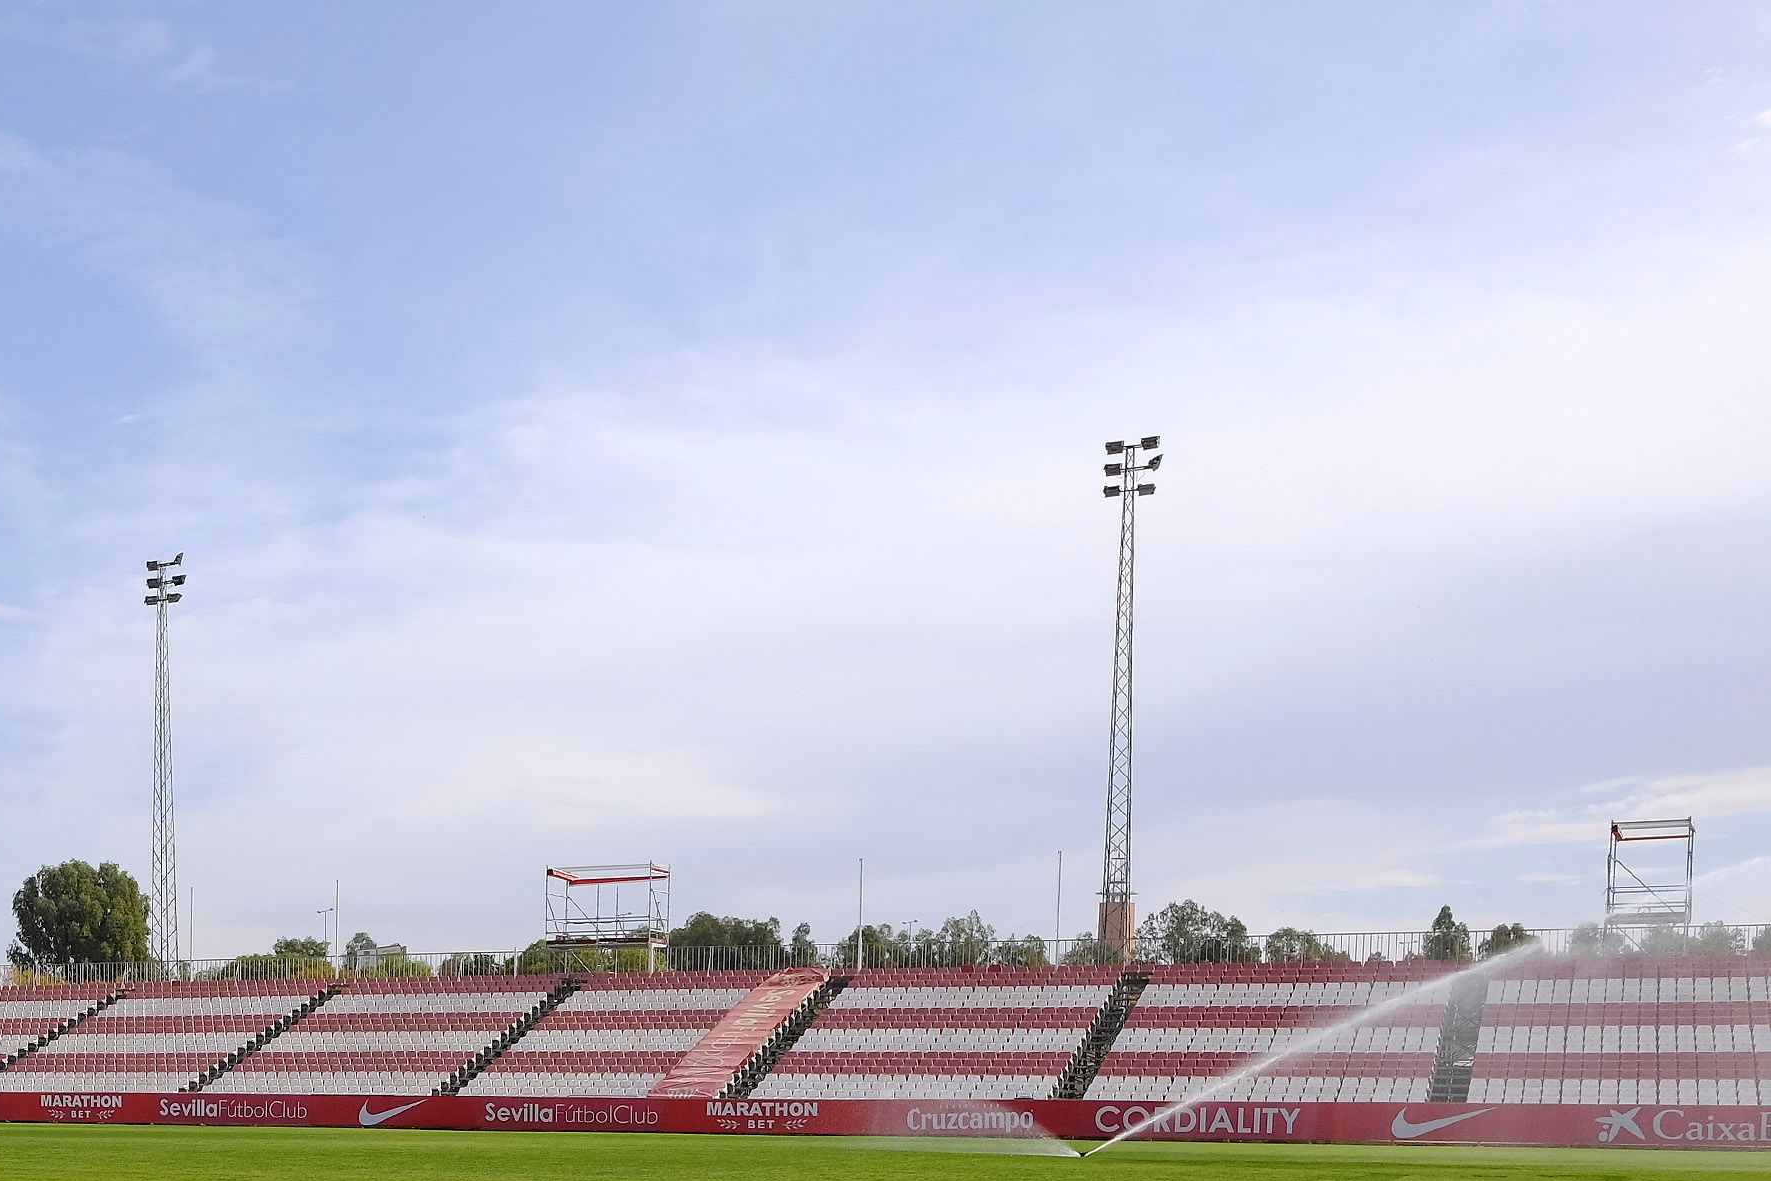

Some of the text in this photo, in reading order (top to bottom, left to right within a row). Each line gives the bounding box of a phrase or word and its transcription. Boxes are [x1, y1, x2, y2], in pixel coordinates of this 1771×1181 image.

[40, 1095, 123, 1108] MARATHON
[71, 1110, 91, 1119] BET
[706, 1101, 819, 1117] MARATHON
[748, 1119, 775, 1129] BET
[907, 1107, 1034, 1133] Cruzcampo
[1094, 1105, 1302, 1134] CORDIALITY
